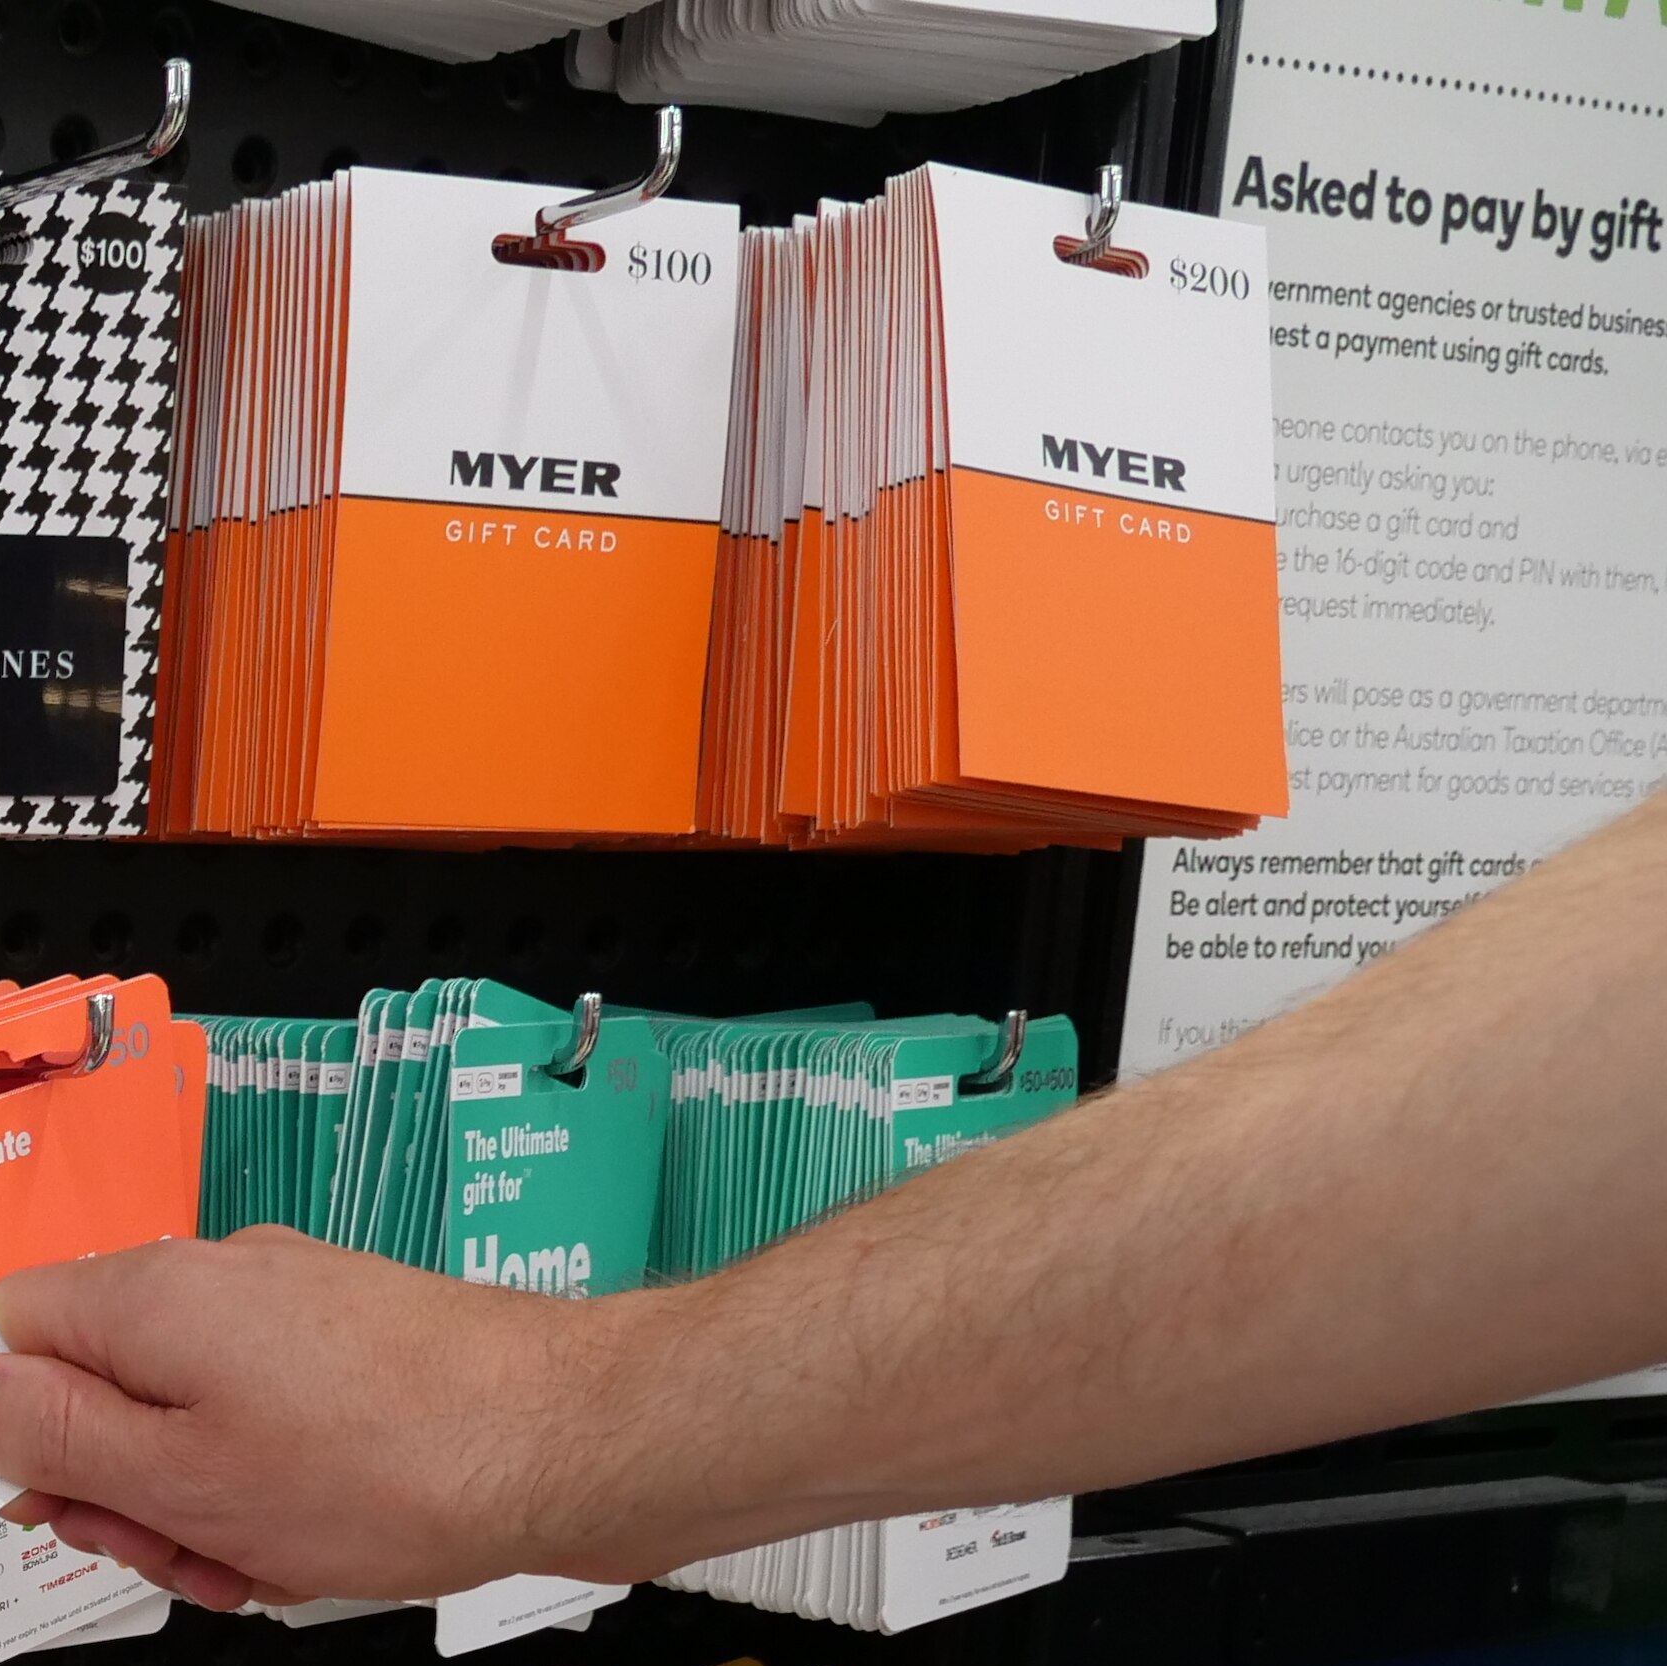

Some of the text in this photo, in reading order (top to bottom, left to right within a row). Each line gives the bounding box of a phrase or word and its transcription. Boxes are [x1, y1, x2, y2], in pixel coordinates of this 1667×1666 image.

[1233, 155, 1663, 261] Asked to pay by gift
[80, 237, 142, 269] $100
[627, 243, 712, 286] $100
[1169, 256, 1250, 301] $200
[450, 450, 621, 498] MYER
[1042, 434, 1186, 493] MYER
[446, 520, 618, 553] GIFT CARD
[1173, 847, 1526, 882] Always remember that gift cards
[463, 1122, 570, 1164] The Ultimate
[39, 1561, 99, 1593] TIMEZONE
